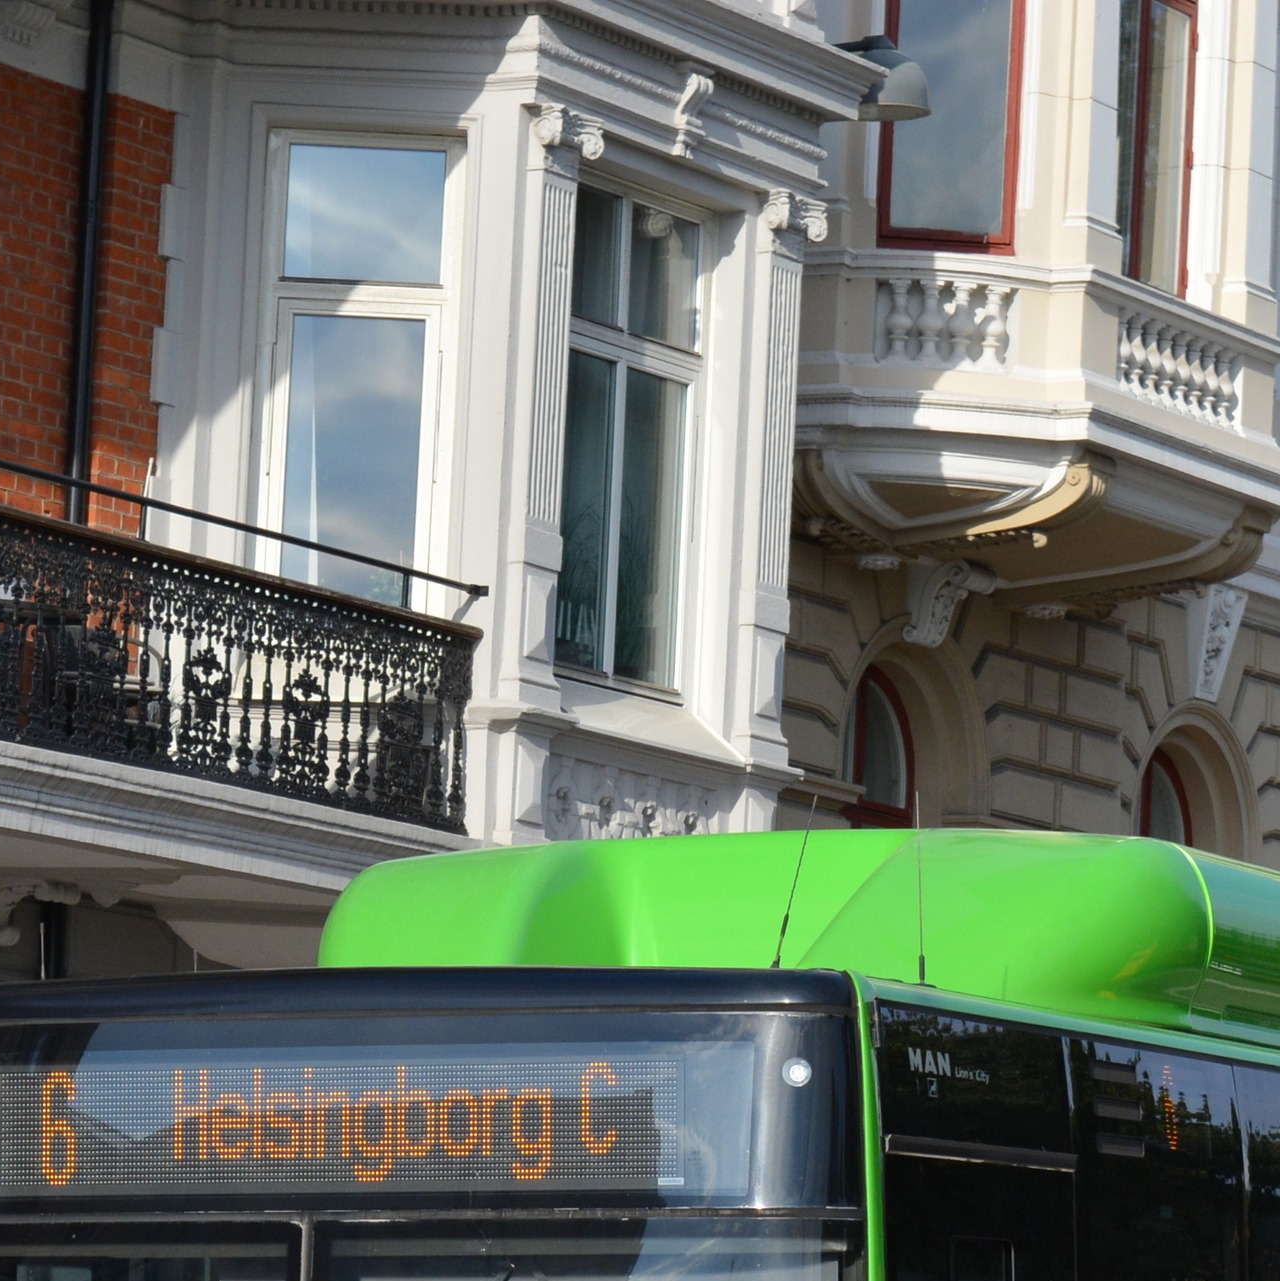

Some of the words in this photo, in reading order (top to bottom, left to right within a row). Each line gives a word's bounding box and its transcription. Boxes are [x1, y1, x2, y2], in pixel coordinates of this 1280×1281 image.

[907, 1046, 952, 1077] MAN
[975, 1069, 990, 1085] City
[40, 1070, 76, 1185] 6
[173, 1066, 552, 1182] Helsingborg
[581, 1061, 616, 1155] C
